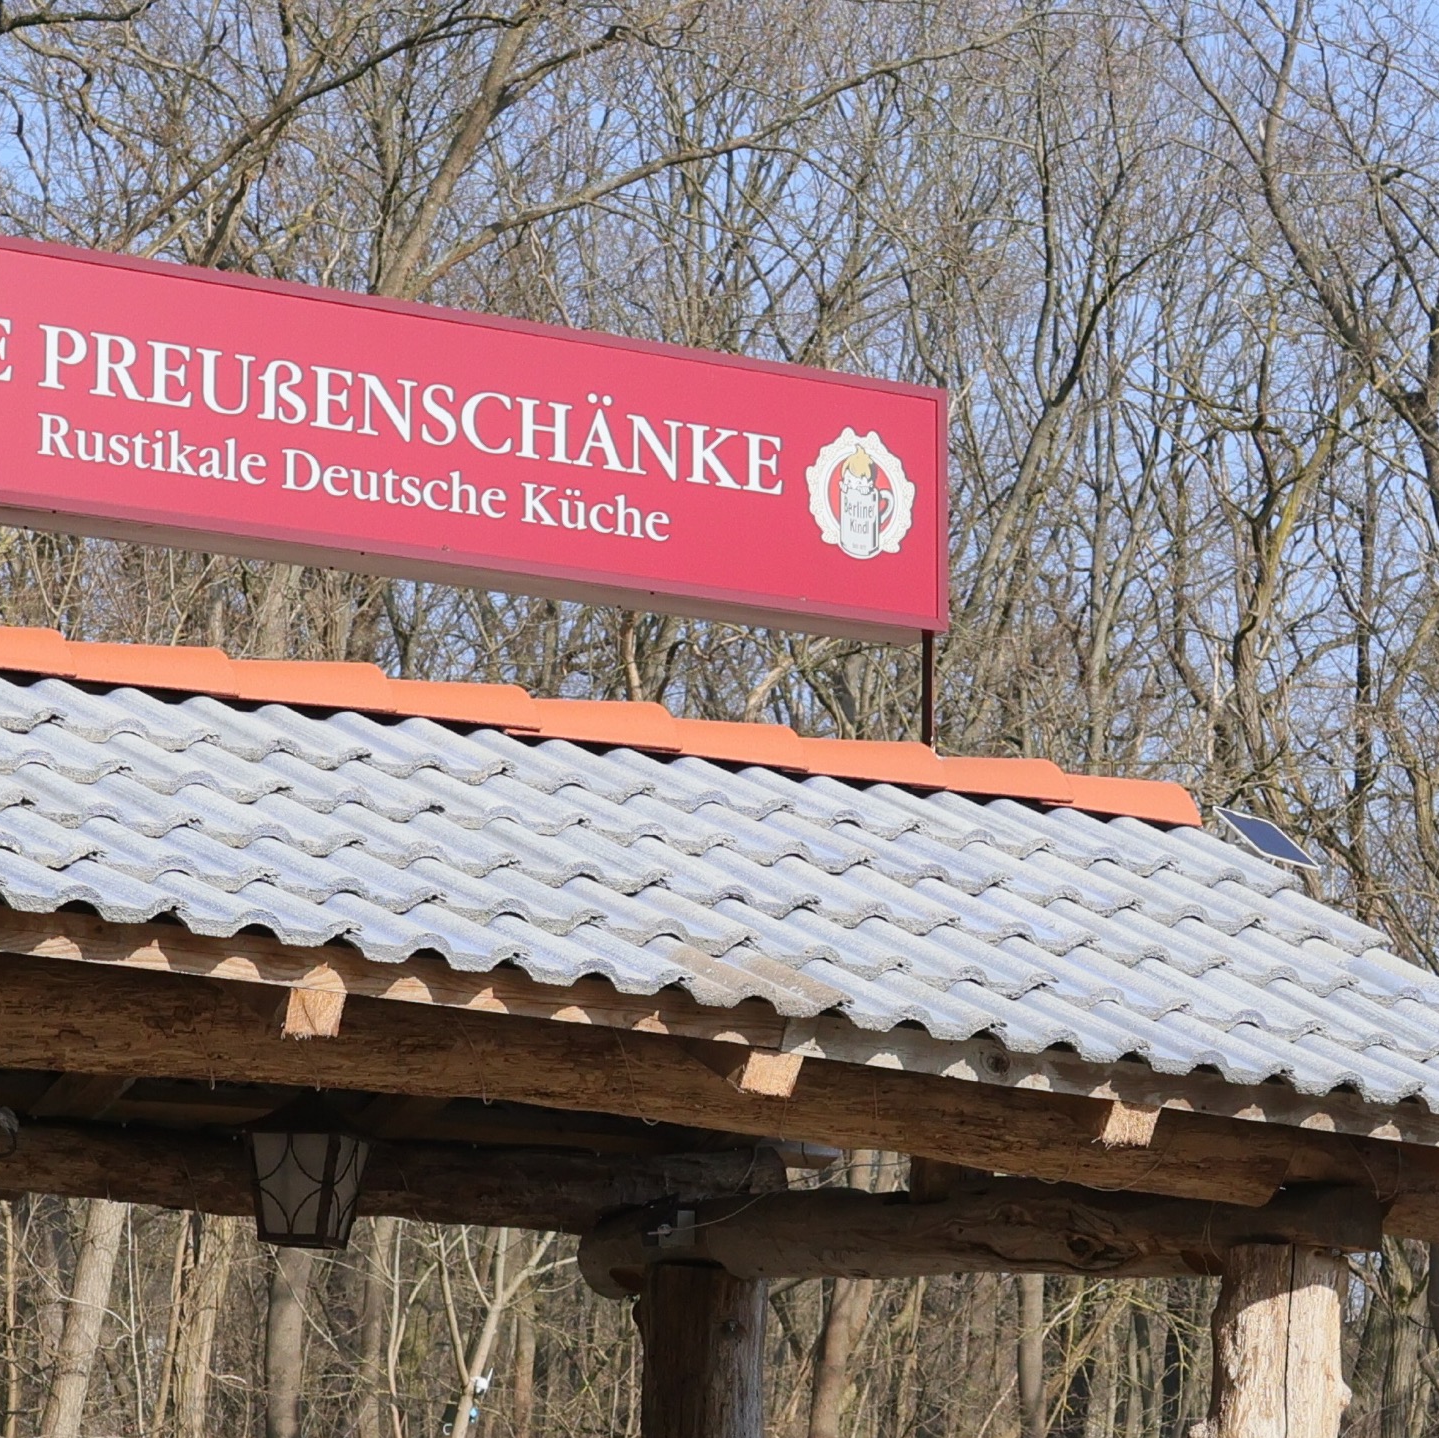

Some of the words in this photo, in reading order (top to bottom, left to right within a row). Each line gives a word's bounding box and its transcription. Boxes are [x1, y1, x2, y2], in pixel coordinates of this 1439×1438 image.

[38, 324, 784, 496] PREUßENSCHÄNKE
[37, 413, 267, 486] Rustikale
[281, 448, 507, 520] Deutsche
[521, 482, 670, 541] Küche
[844, 496, 875, 519] Berliner
[850, 519, 869, 534] Kindl
